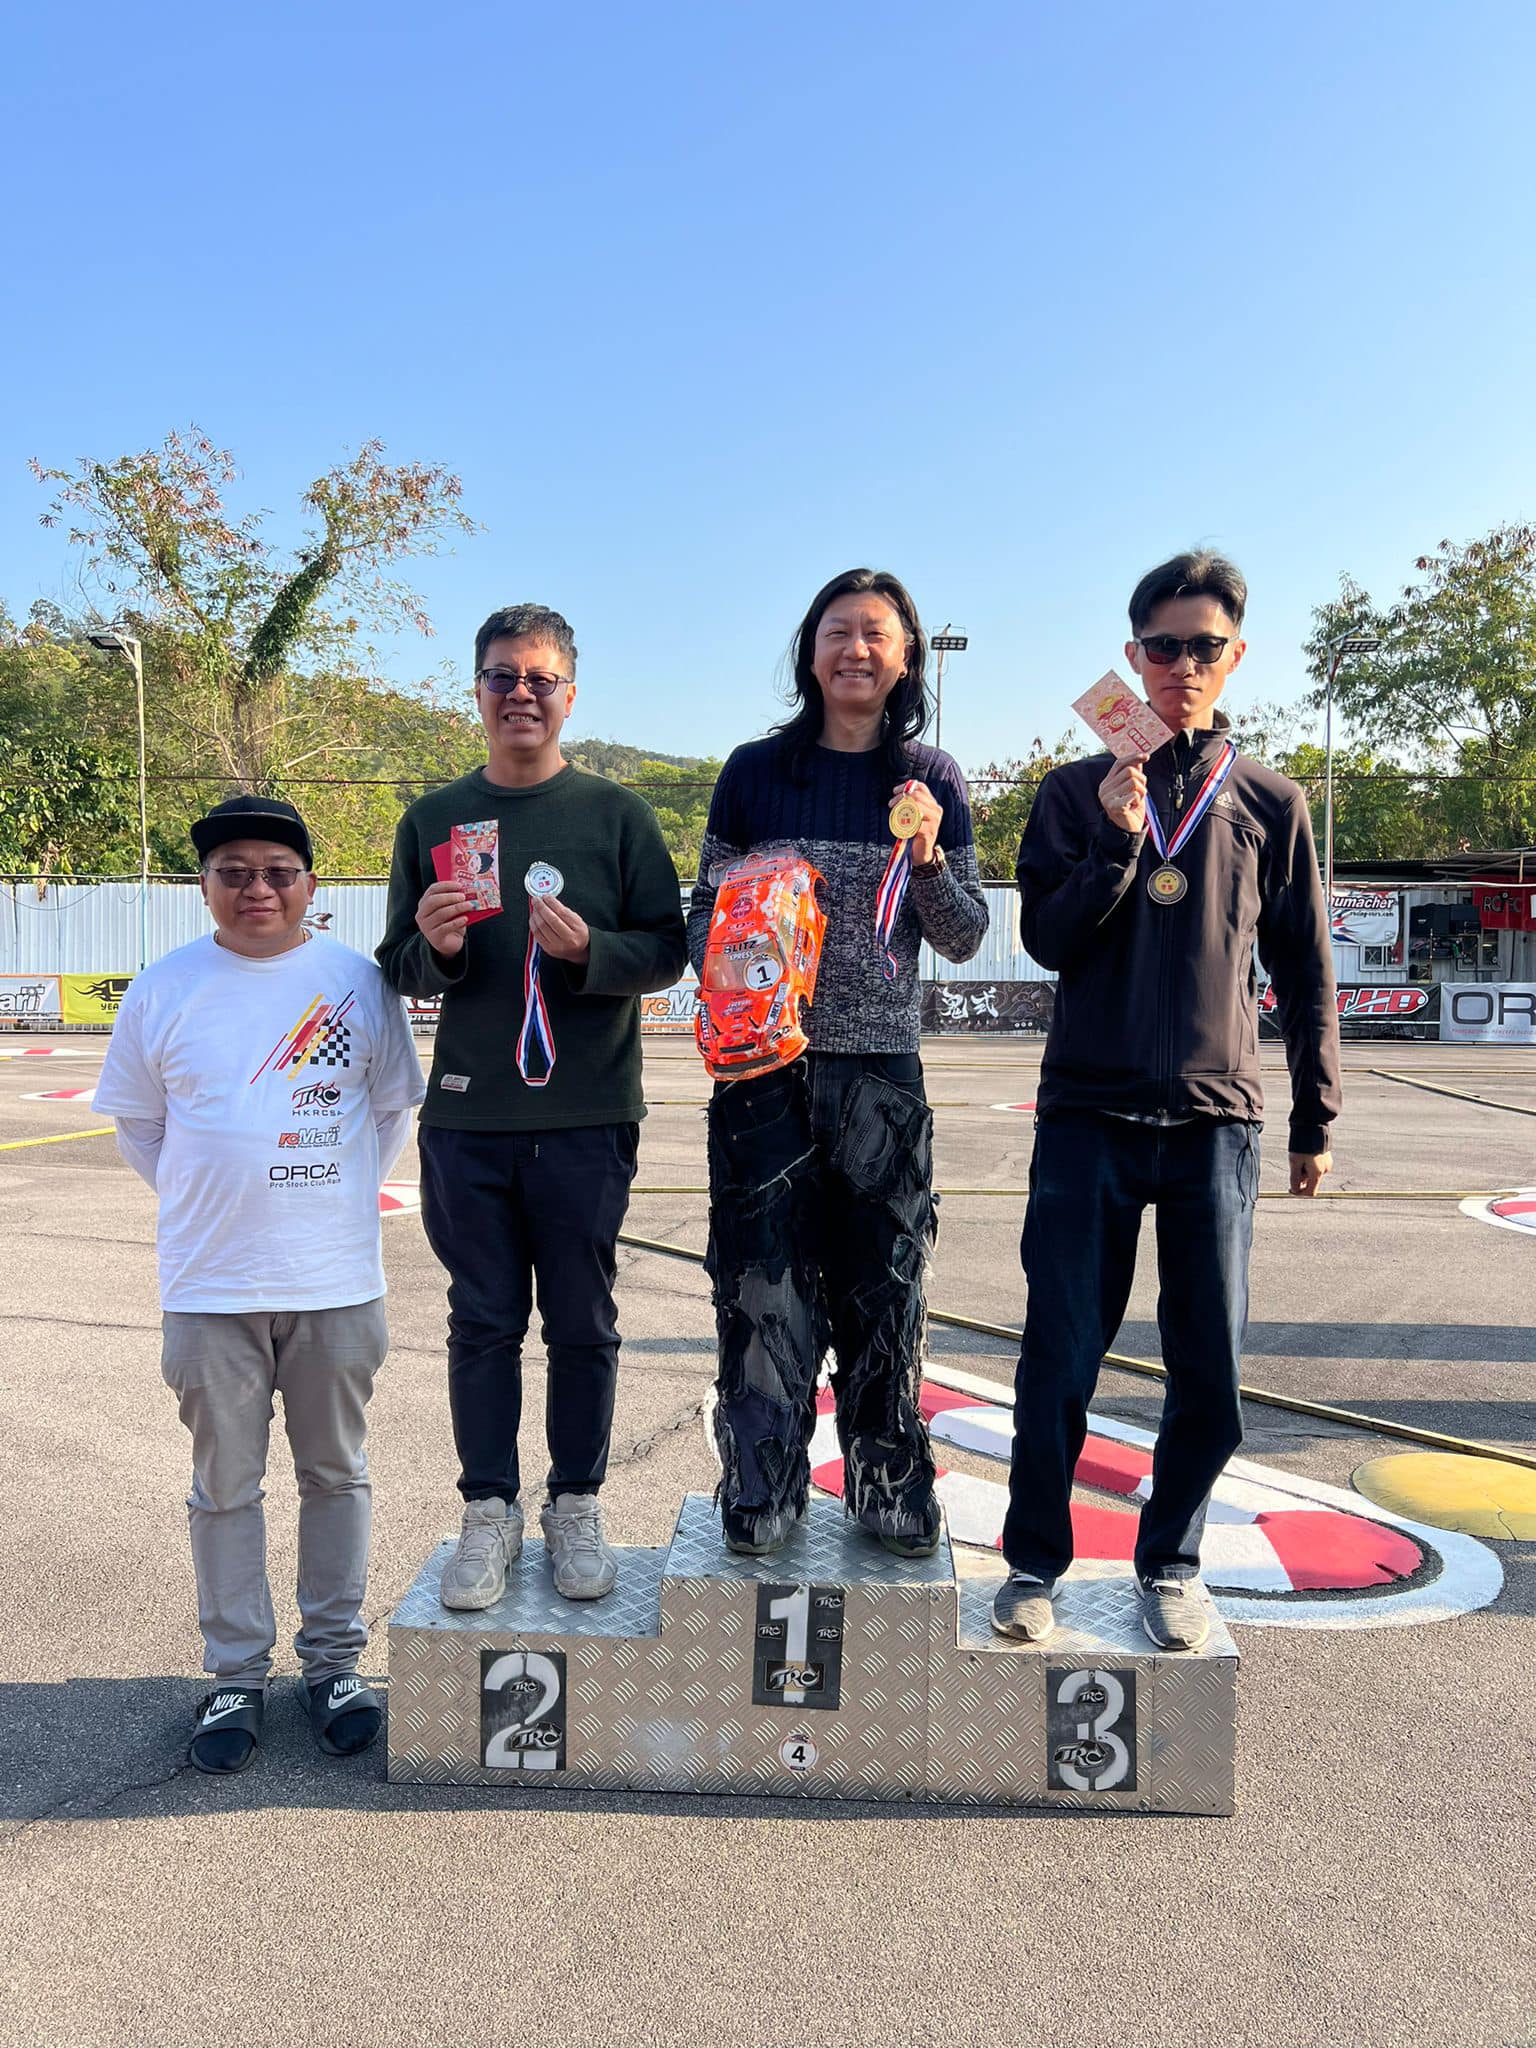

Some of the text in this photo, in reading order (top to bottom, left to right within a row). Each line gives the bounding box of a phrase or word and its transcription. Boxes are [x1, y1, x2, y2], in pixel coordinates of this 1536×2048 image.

[756, 966, 771, 983] 1
[292, 1080, 341, 1108] TRC
[269, 1163, 340, 1181] ORCA
[269, 1181, 284, 1189] Pro
[286, 1180, 309, 1188] Stock
[770, 1585, 810, 1703] 1
[770, 1665, 820, 1689] TRC
[333, 1679, 361, 1696] NIKE
[211, 1694, 248, 1711] NIKE
[484, 1652, 560, 1770] 2
[1057, 1669, 1129, 1791] 3
[791, 1745, 806, 1763] 4
